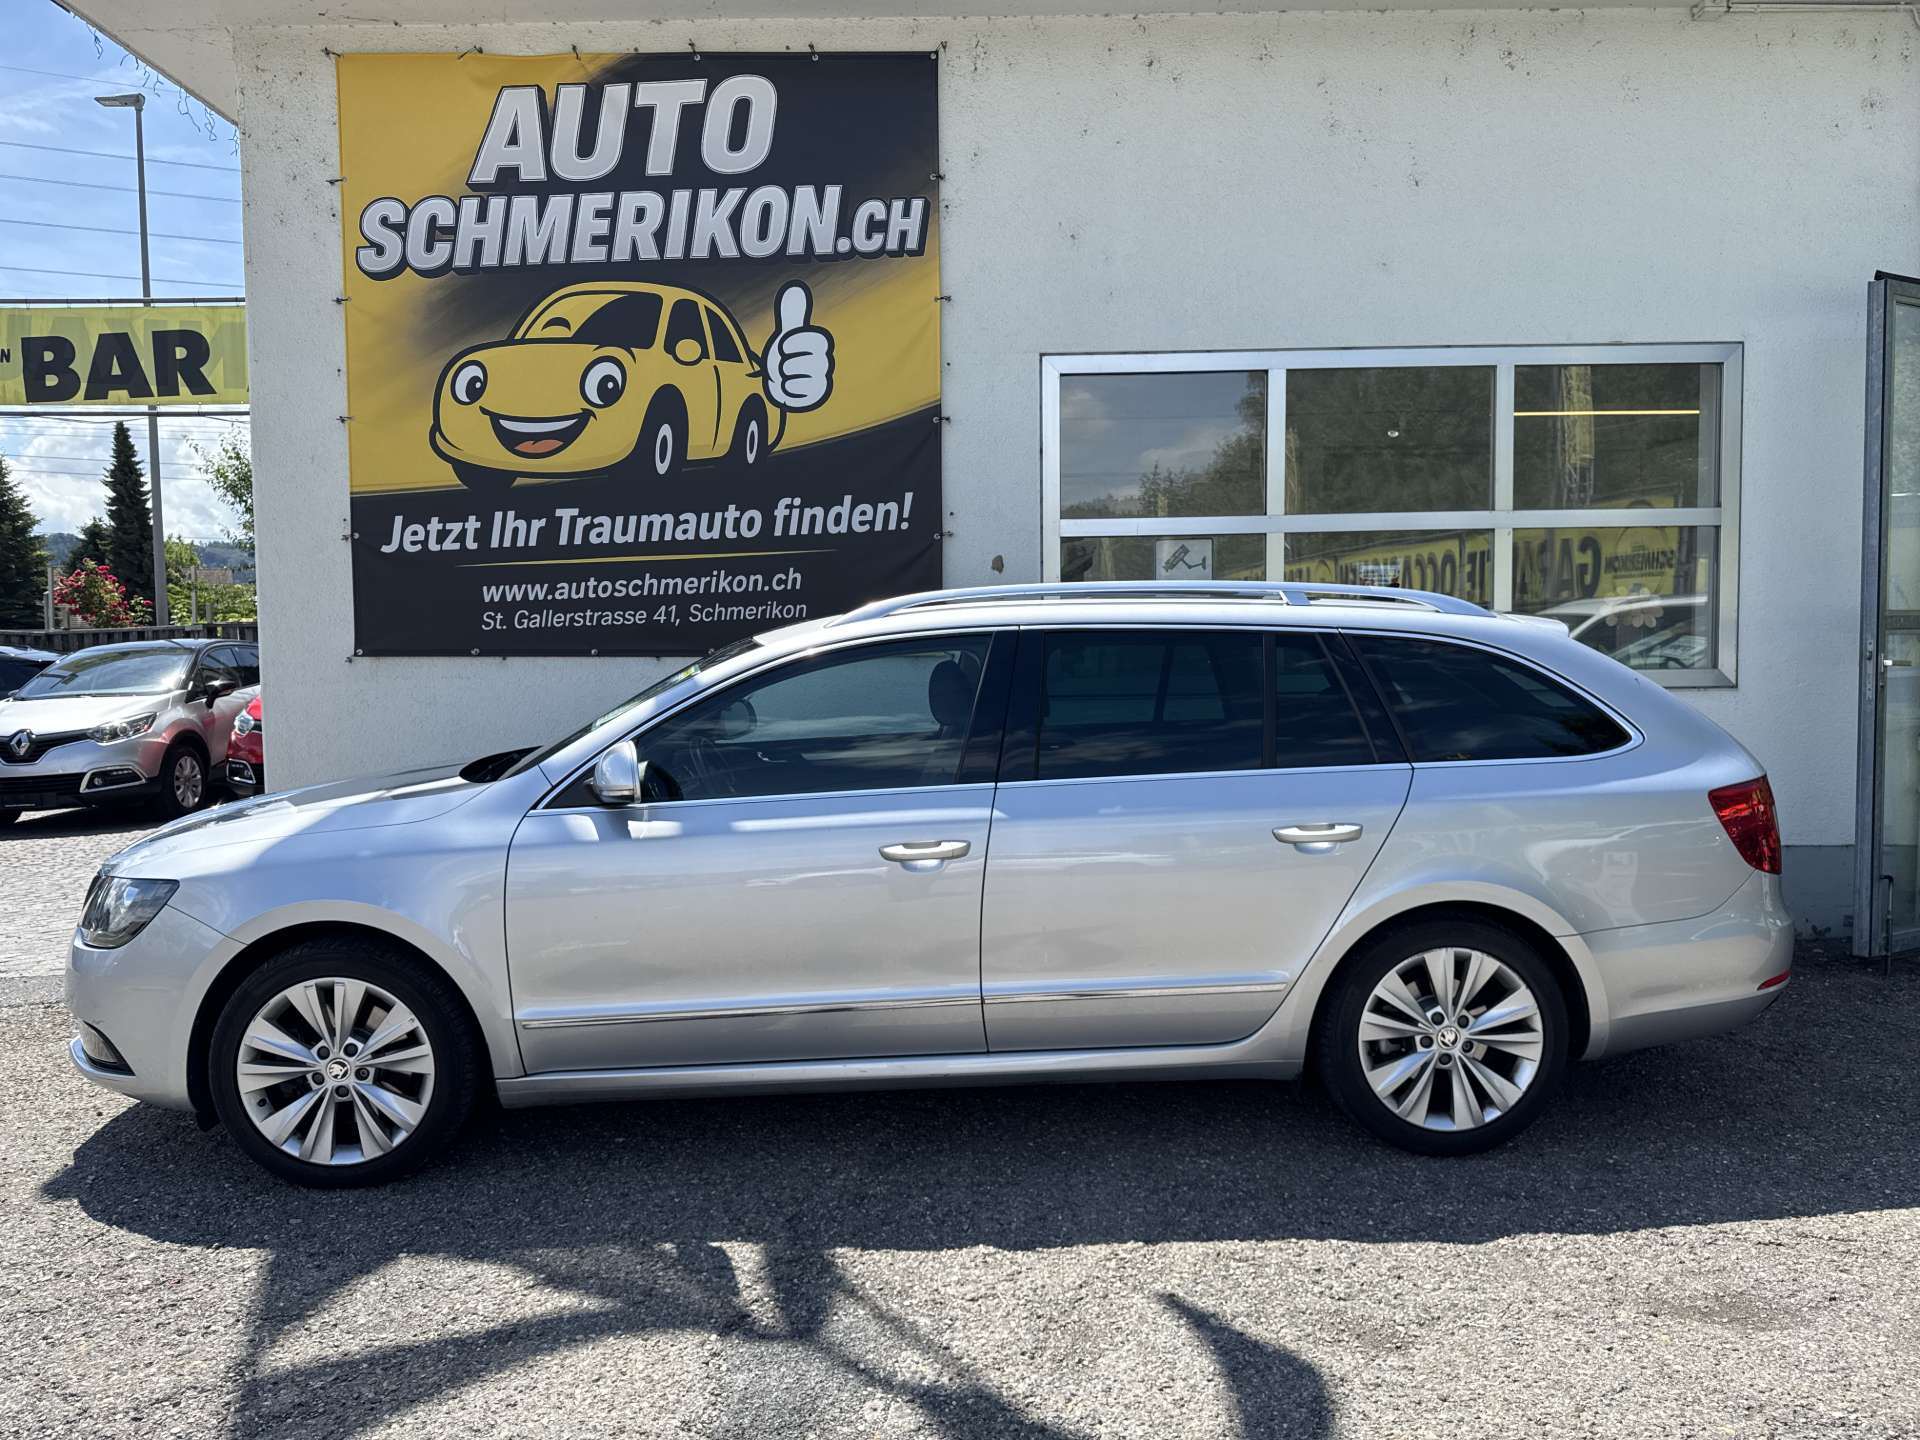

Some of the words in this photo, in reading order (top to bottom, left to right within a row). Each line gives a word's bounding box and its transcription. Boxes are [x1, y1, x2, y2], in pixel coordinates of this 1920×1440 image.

[466, 74, 778, 184] AUTO
[356, 183, 927, 273] SCHMERIKON.CH
[20, 329, 217, 404] BAR
[380, 516, 482, 553] Jetzt
[490, 511, 547, 548] Ihr
[555, 505, 763, 546] Traumauto
[773, 491, 914, 537] finden!
[481, 611, 507, 631] St.
[514, 609, 647, 629] Gallerstrasse
[652, 604, 681, 627] 41,
[688, 600, 807, 623] Schmerikon
[482, 568, 802, 603] www.autoschmerikon.ch
